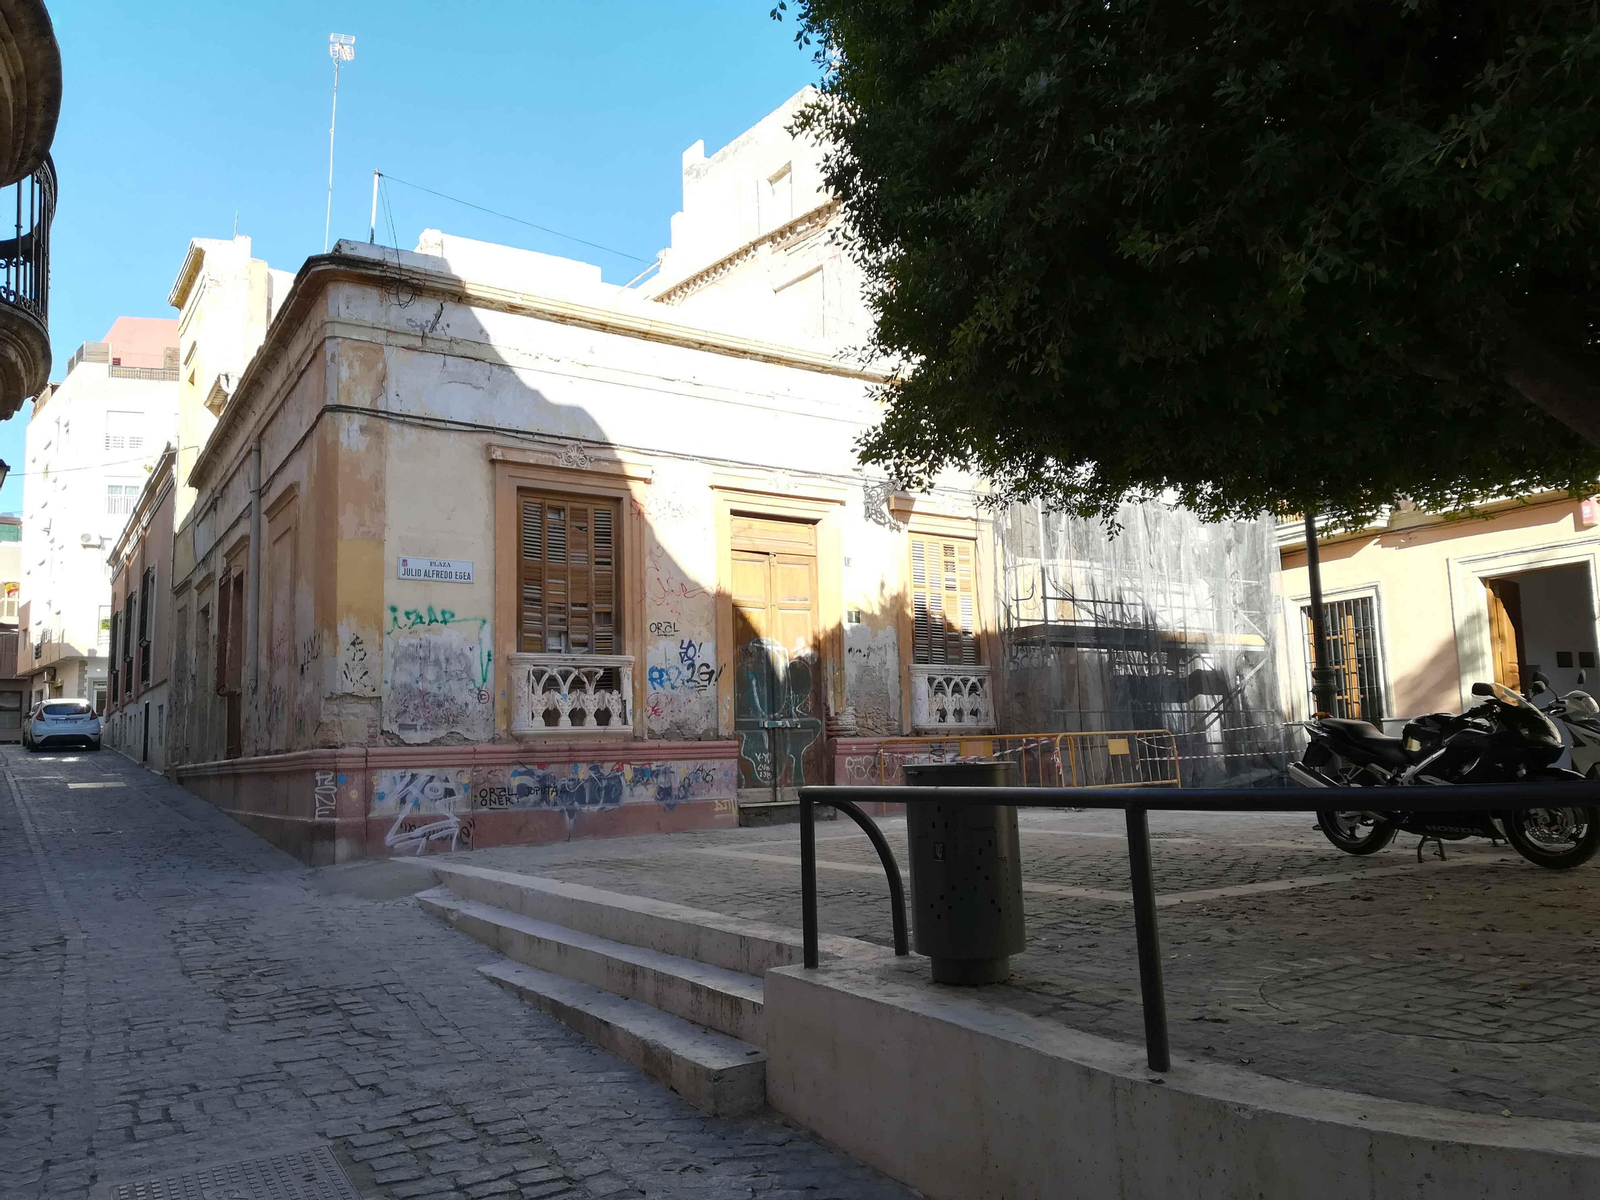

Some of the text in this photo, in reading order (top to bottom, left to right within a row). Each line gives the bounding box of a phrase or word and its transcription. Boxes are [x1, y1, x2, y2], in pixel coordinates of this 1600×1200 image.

[402, 568, 471, 580] JULIO ALFREDO EGEA
[1425, 825, 1484, 835] HONDA
